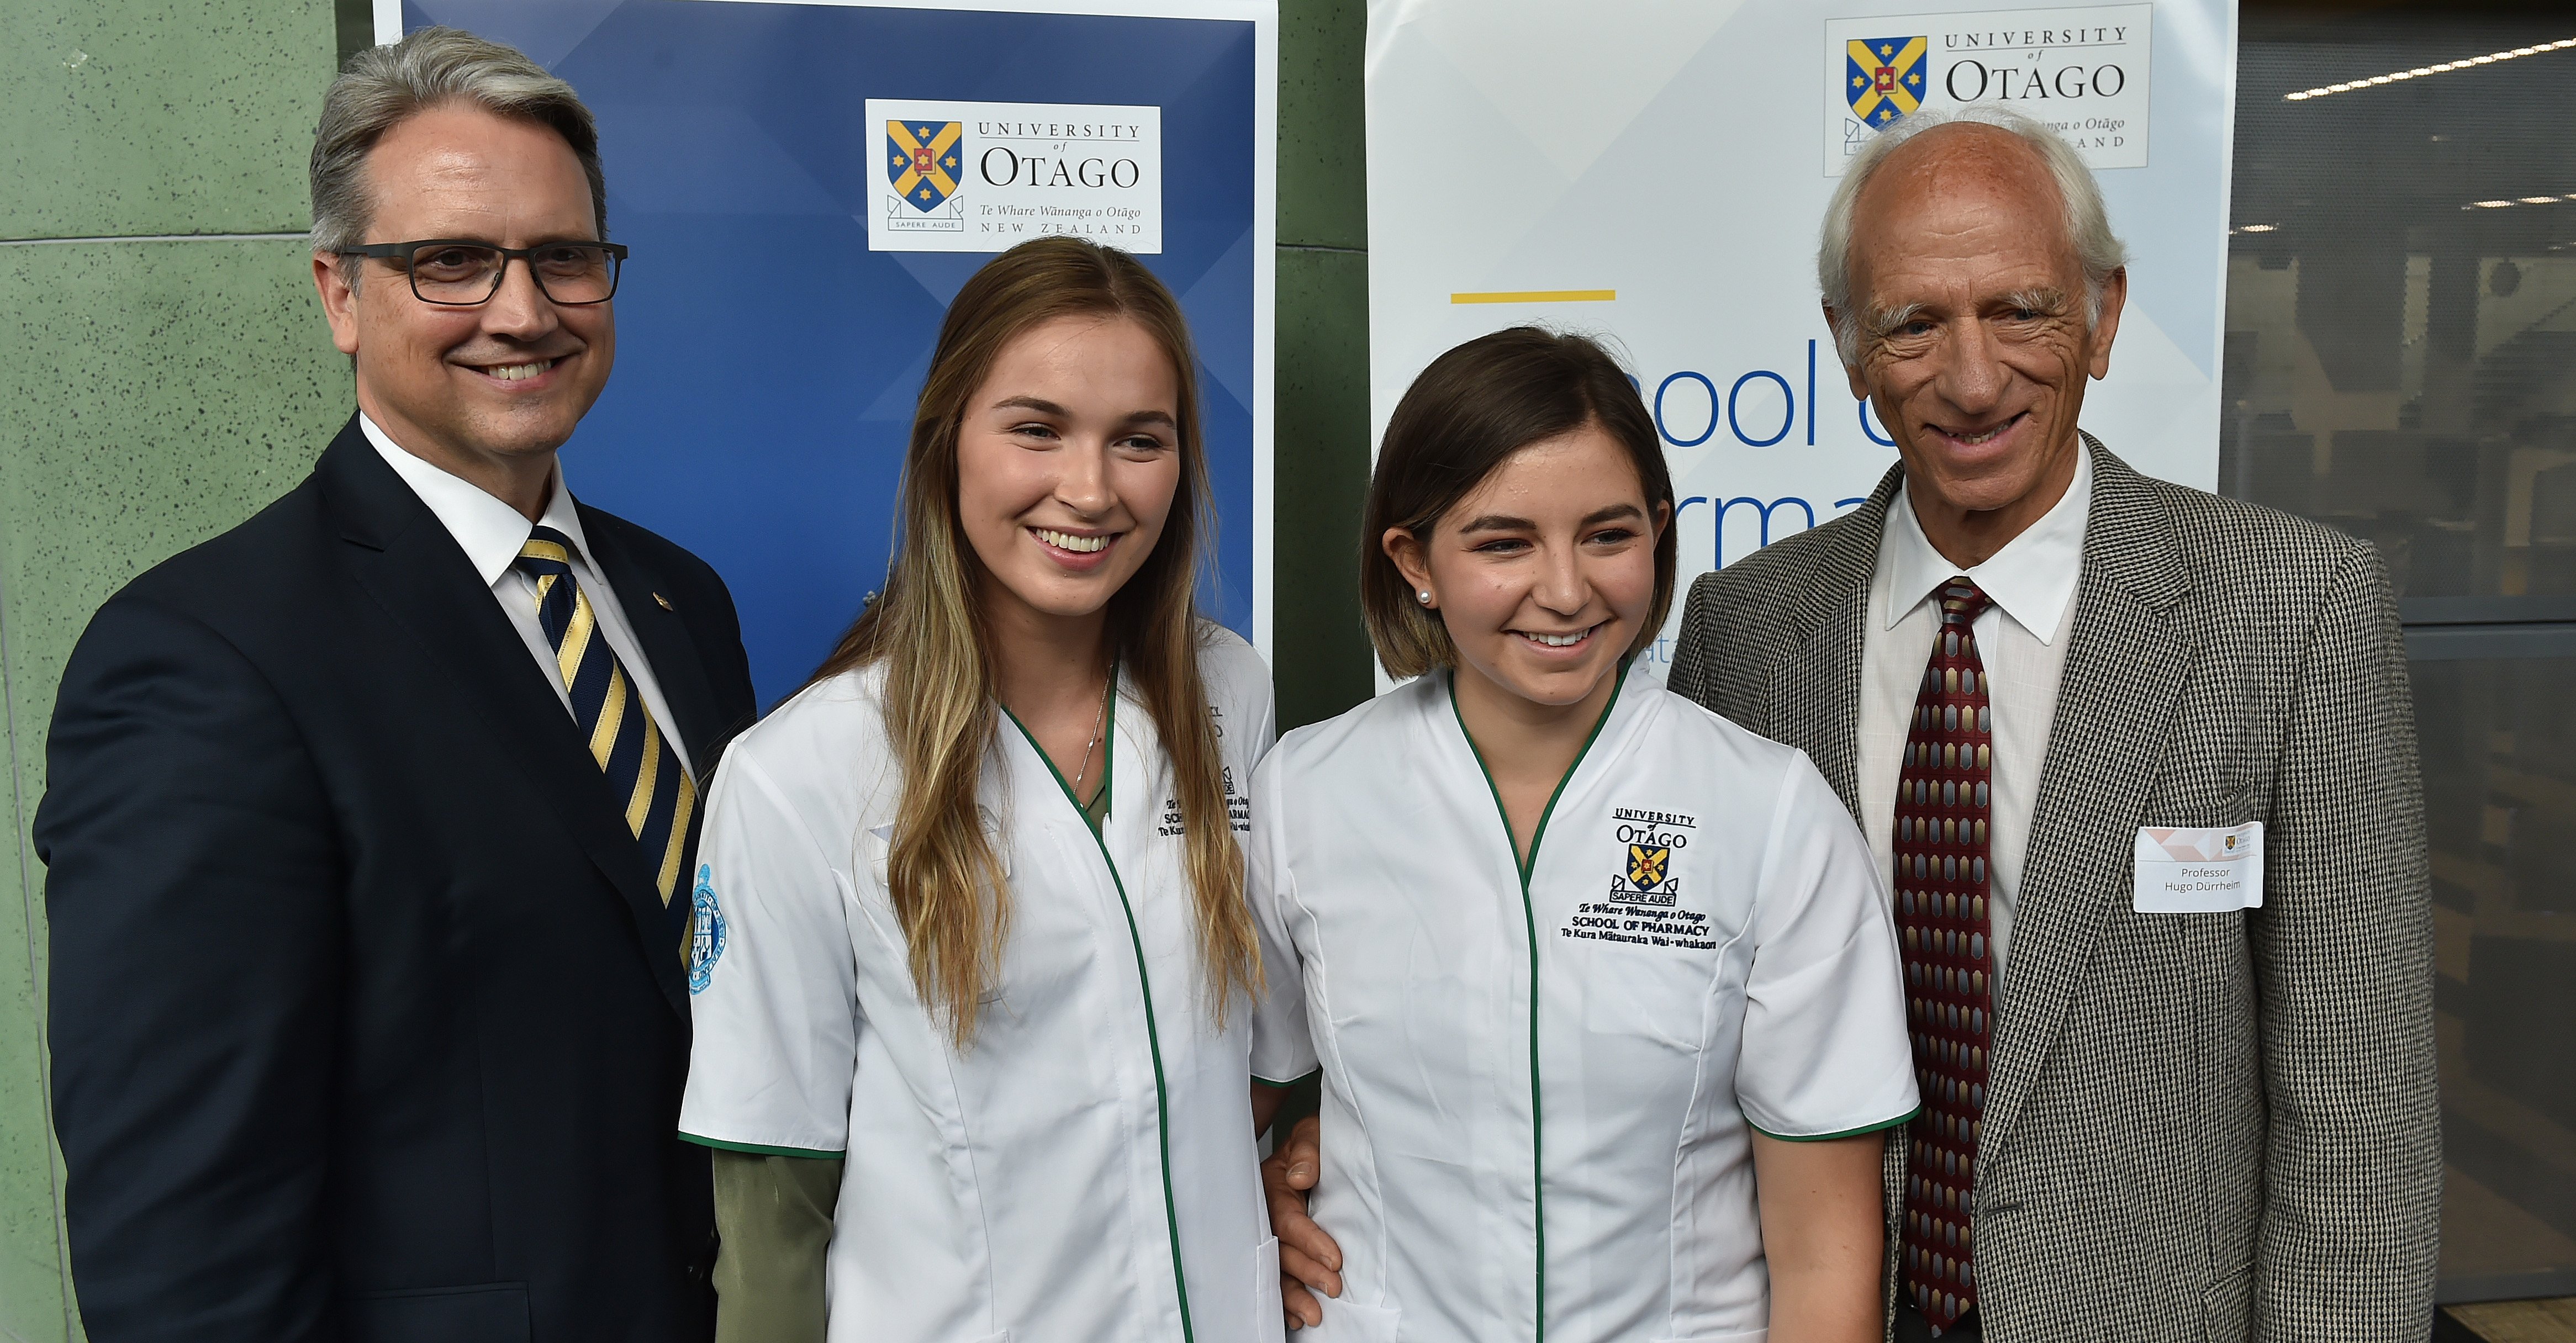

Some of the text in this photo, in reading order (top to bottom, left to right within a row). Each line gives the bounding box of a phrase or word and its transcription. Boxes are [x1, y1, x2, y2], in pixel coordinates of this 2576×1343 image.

[1945, 26, 2128, 48] UNIVERSITY
[2028, 50, 2044, 61] of
[1946, 59, 2125, 102] OTAGO
[978, 121, 1140, 138] UNIVERSITY
[2086, 118, 2125, 132] Otāgo
[1053, 142, 1067, 152] of
[980, 146, 1140, 188] OTAGO
[980, 205, 993, 215] Te
[997, 205, 1036, 216] Whare
[1040, 205, 1092, 220] Wānanga
[1106, 207, 1141, 220] Otāgo
[981, 223, 1141, 234] NEW ZEALAND
[1627, 339, 1816, 447] ool
[1615, 808, 1695, 825] UNIVERSITY
[1158, 827, 1169, 837] Te
[1616, 824, 1687, 849] OTAGO
[2181, 868, 2230, 877] Professor
[2165, 880, 2240, 893] Hugo Dürrheim
[1612, 892, 1674, 904] SAPERE AUDE
[1579, 903, 1591, 912] Te
[1592, 903, 1623, 915] Whare
[1670, 911, 1676, 919] o
[1561, 928, 1572, 938] Te
[1574, 929, 1596, 939] Kura
[1572, 916, 1710, 936] SCHOOL OF PHARMACY
